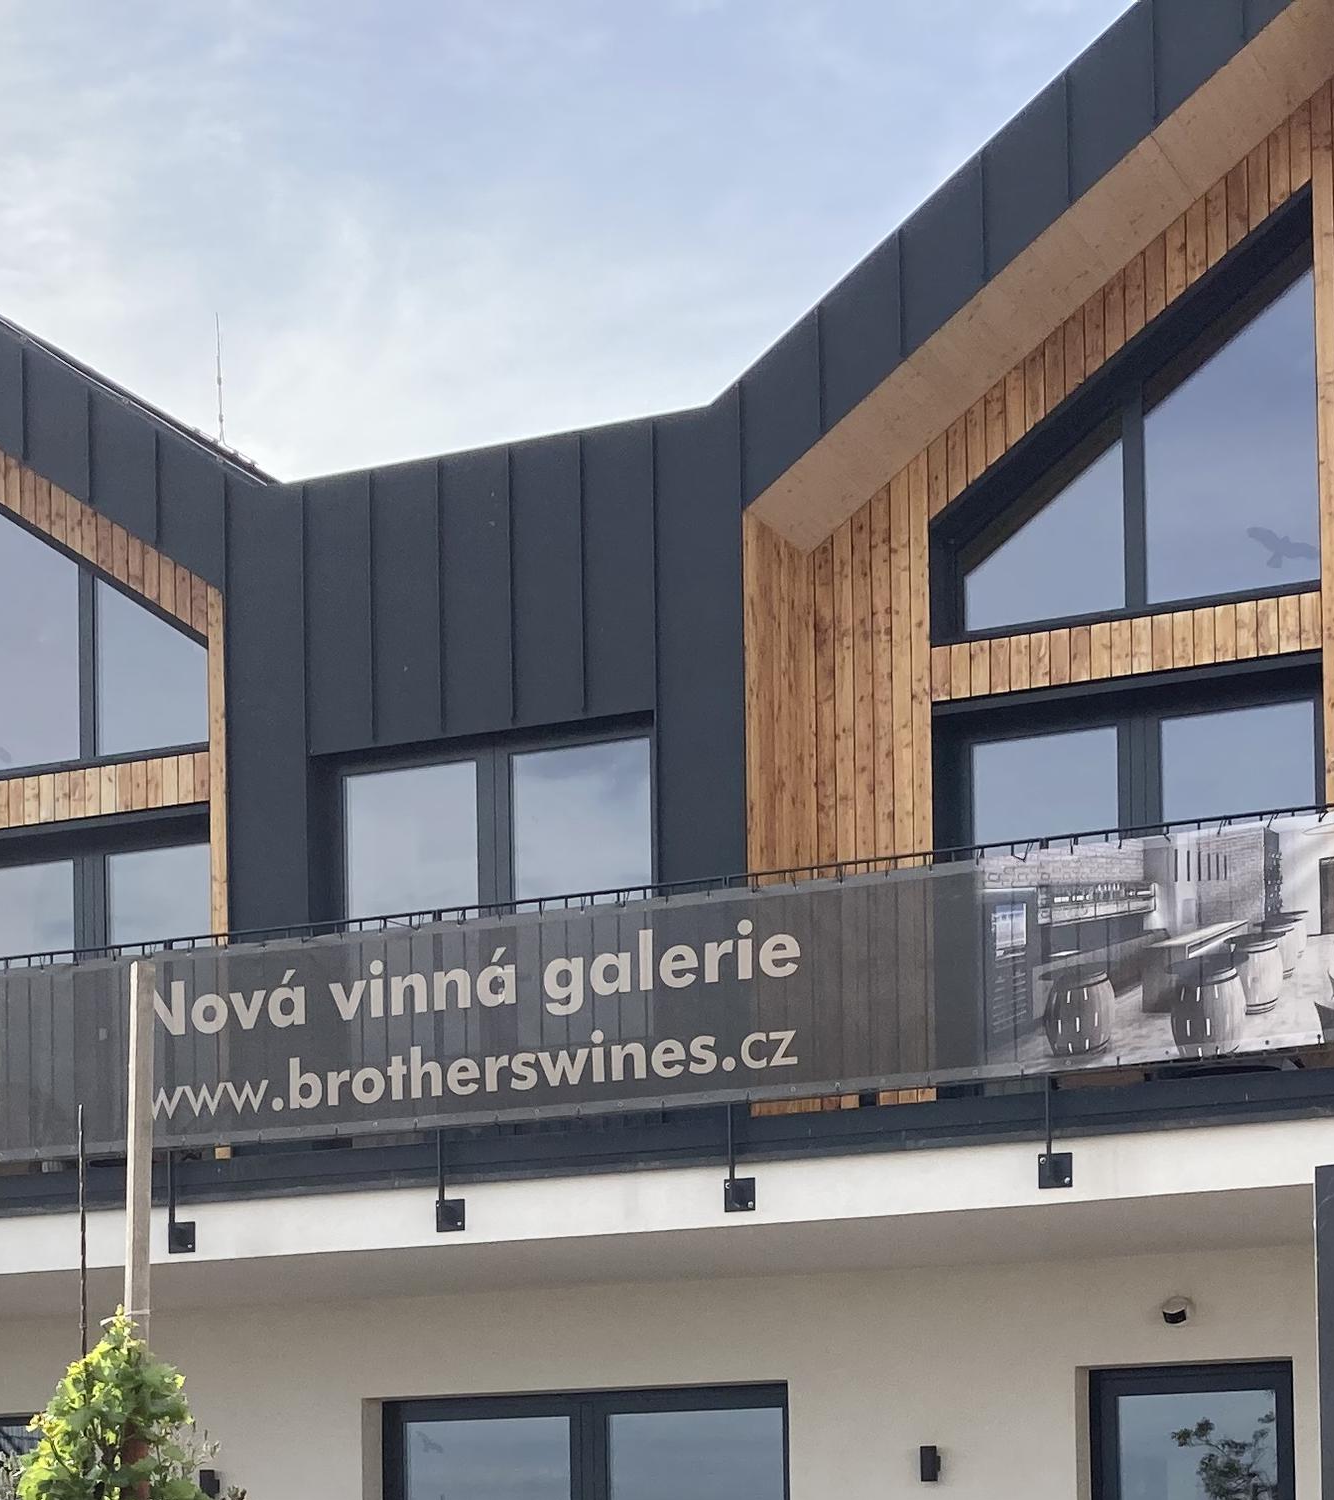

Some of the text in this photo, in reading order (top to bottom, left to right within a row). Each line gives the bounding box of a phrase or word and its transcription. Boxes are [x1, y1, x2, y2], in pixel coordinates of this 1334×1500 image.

[153, 919, 801, 1036] Nová vinná galerie
[151, 1027, 799, 1121] www.brotherswines.cz
